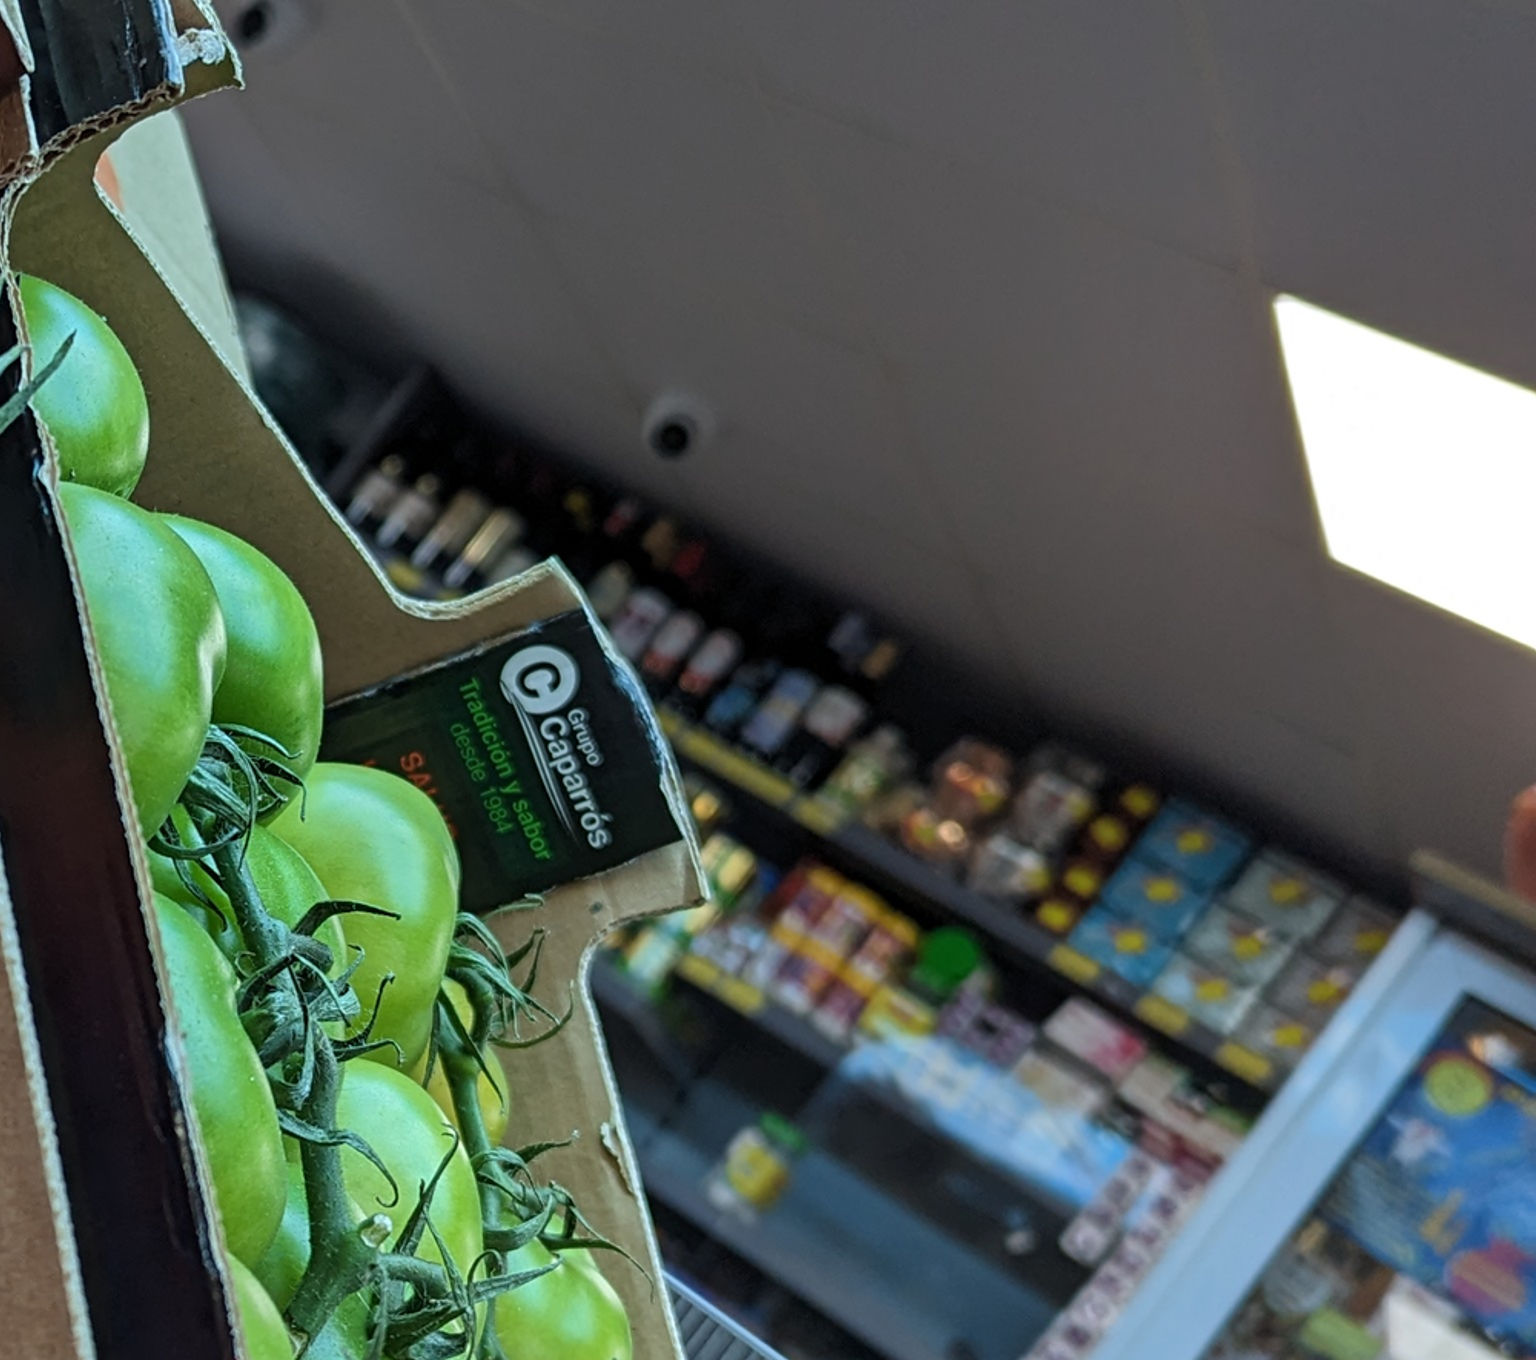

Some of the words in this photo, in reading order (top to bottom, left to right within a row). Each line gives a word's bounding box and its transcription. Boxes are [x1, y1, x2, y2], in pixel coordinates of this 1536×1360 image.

[449, 722, 487, 783] desde
[479, 787, 513, 835] 1984
[459, 676, 514, 779] Tradición
[499, 779, 521, 795] y
[512, 799, 552, 861] sabor
[540, 715, 612, 849] Caparrós
[566, 708, 602, 766] Grupo
